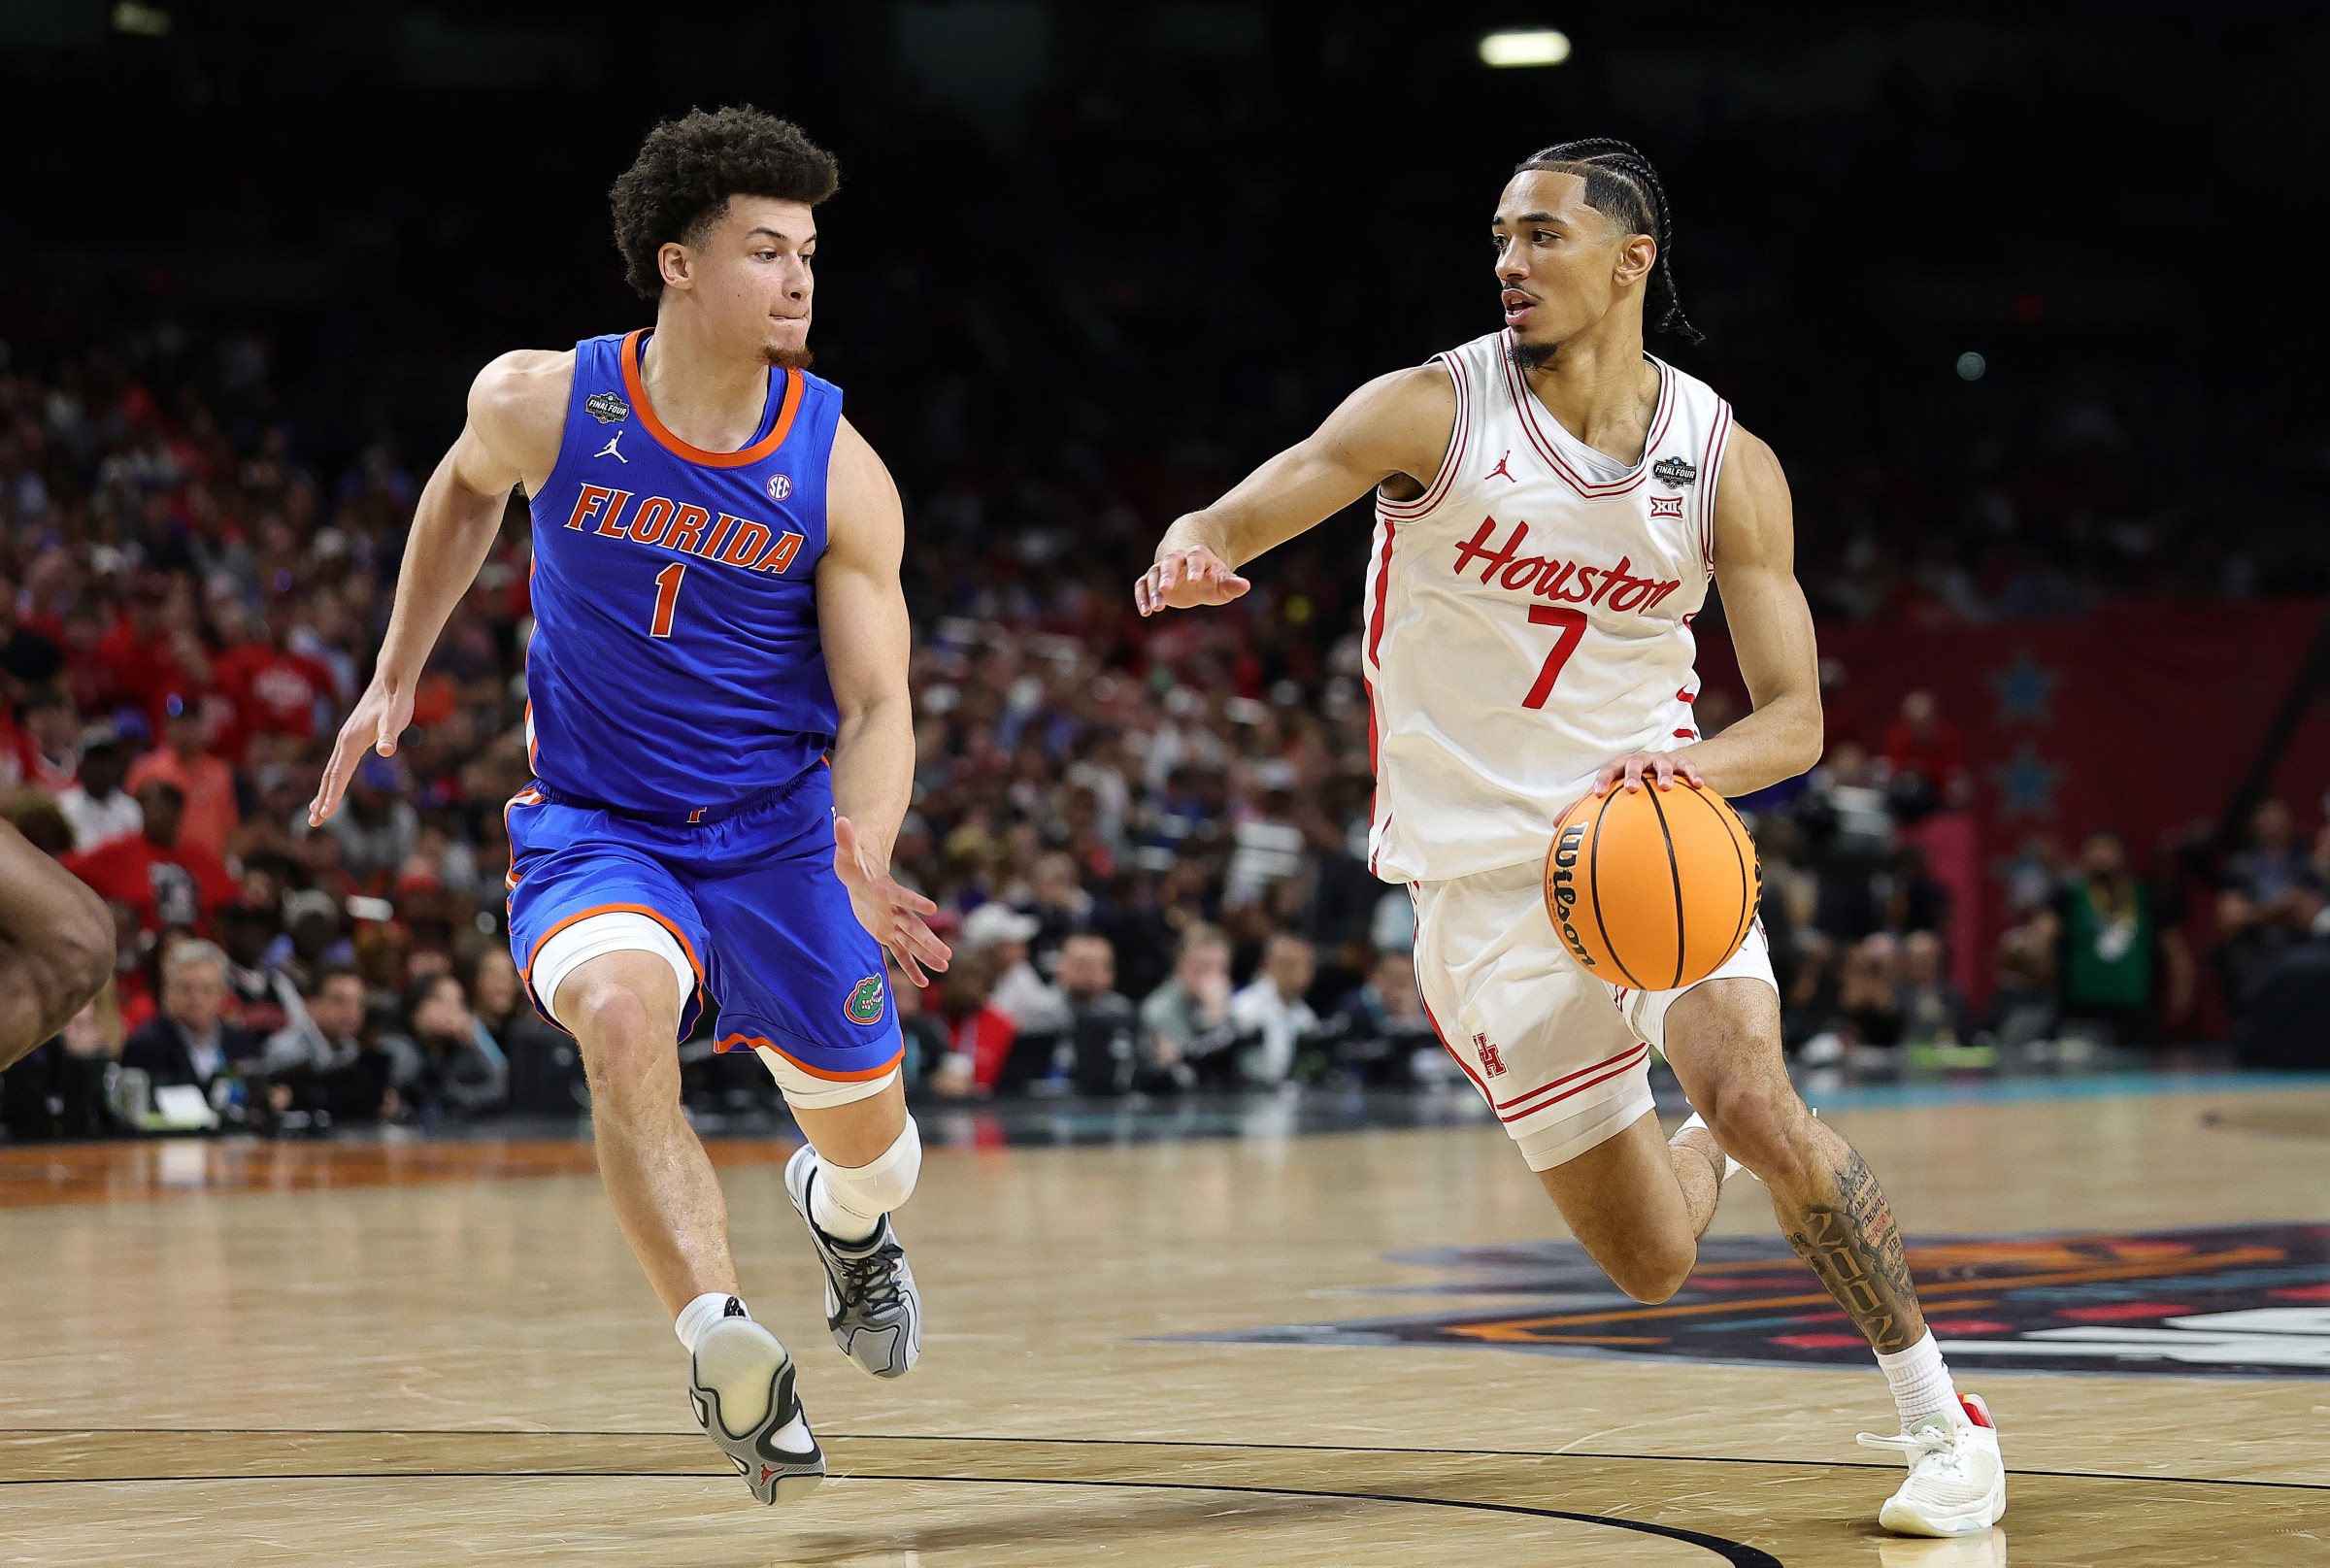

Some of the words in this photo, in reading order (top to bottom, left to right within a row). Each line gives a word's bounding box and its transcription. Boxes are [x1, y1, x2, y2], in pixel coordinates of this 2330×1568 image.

[588, 399, 609, 412] FINAL
[607, 405, 627, 417] FOUR
[1655, 465, 1676, 476] FINAL
[1676, 468, 1695, 479] FOUR
[768, 476, 791, 499] SEC
[1650, 497, 1682, 517] XII
[563, 483, 804, 574] FLORIDA
[1453, 515, 1681, 614] Houston
[649, 561, 686, 638] 1
[1521, 604, 1587, 710] 7
[1553, 820, 1598, 967] Wilson
[1855, 1171, 1869, 1191] CAN
[1853, 1196, 1869, 1216] ALL
